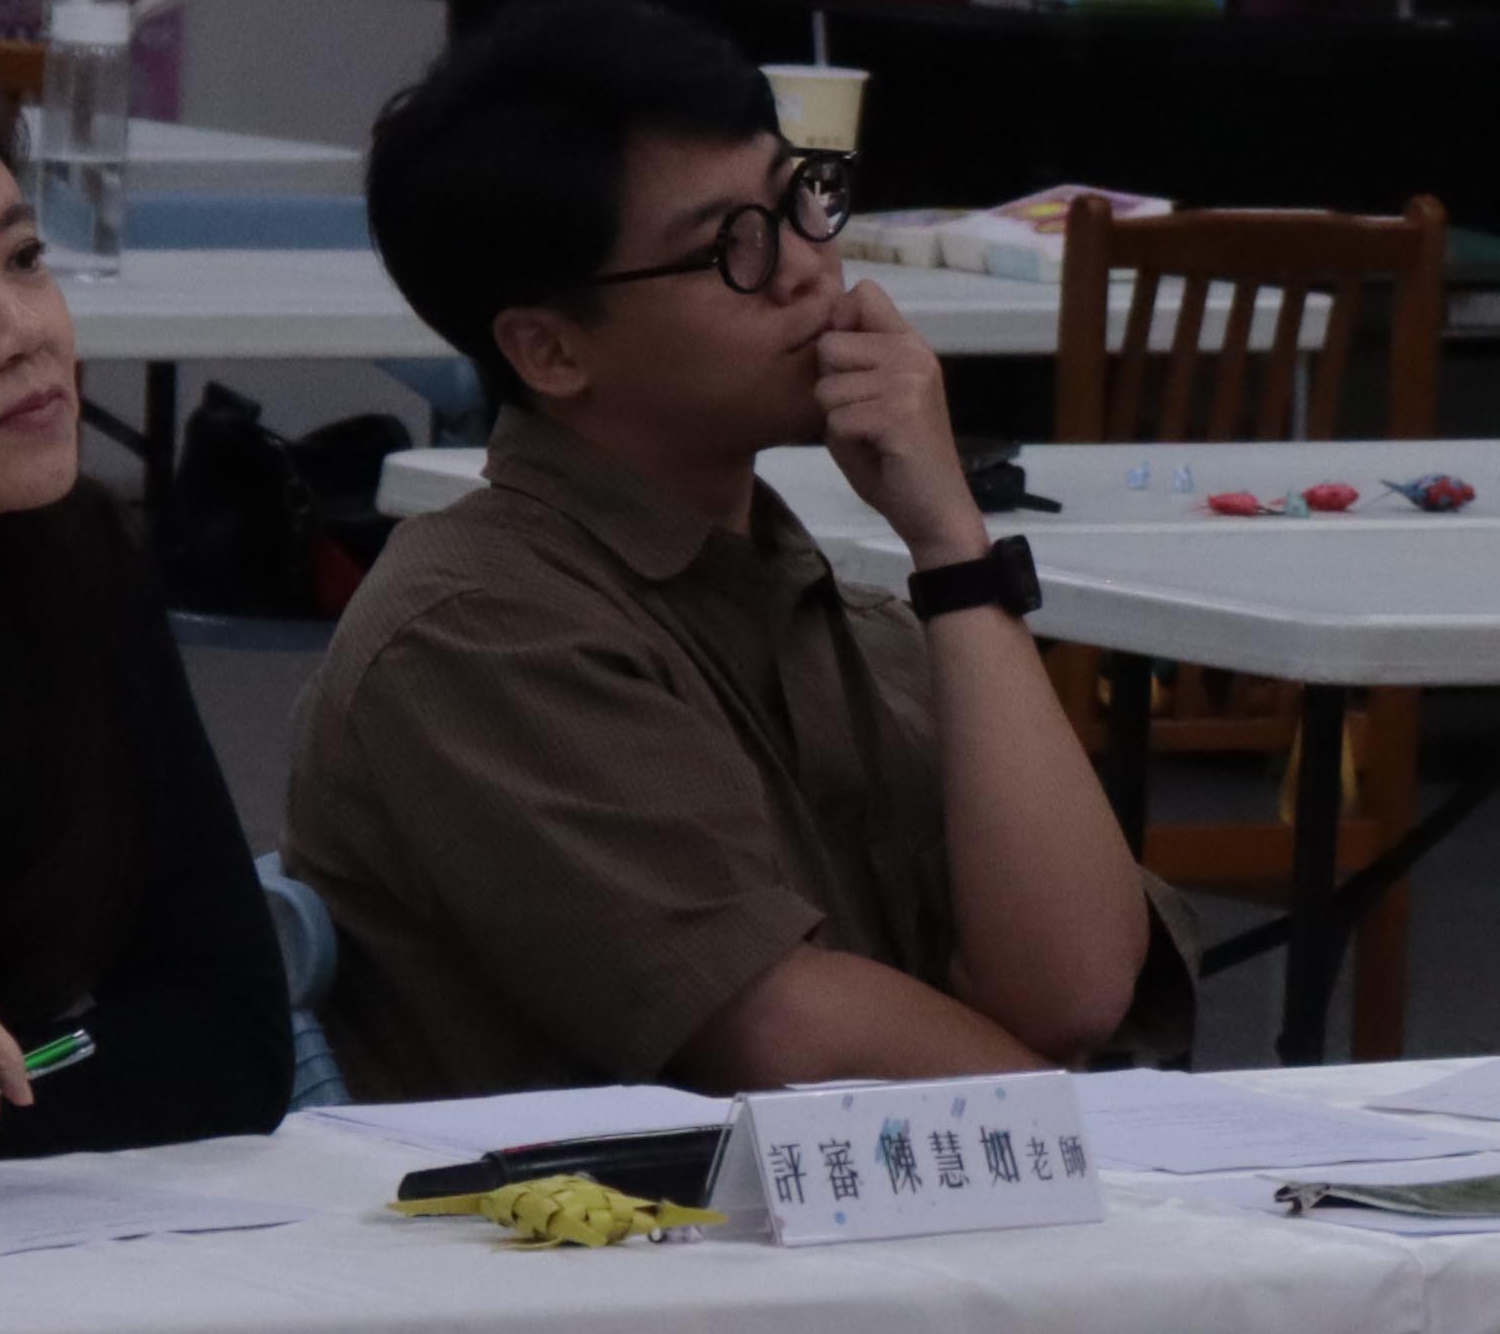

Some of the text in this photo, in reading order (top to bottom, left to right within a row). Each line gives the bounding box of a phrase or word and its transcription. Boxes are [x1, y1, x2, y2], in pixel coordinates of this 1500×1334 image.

[768, 1125, 1088, 1204] 評審 陳慧如老師
